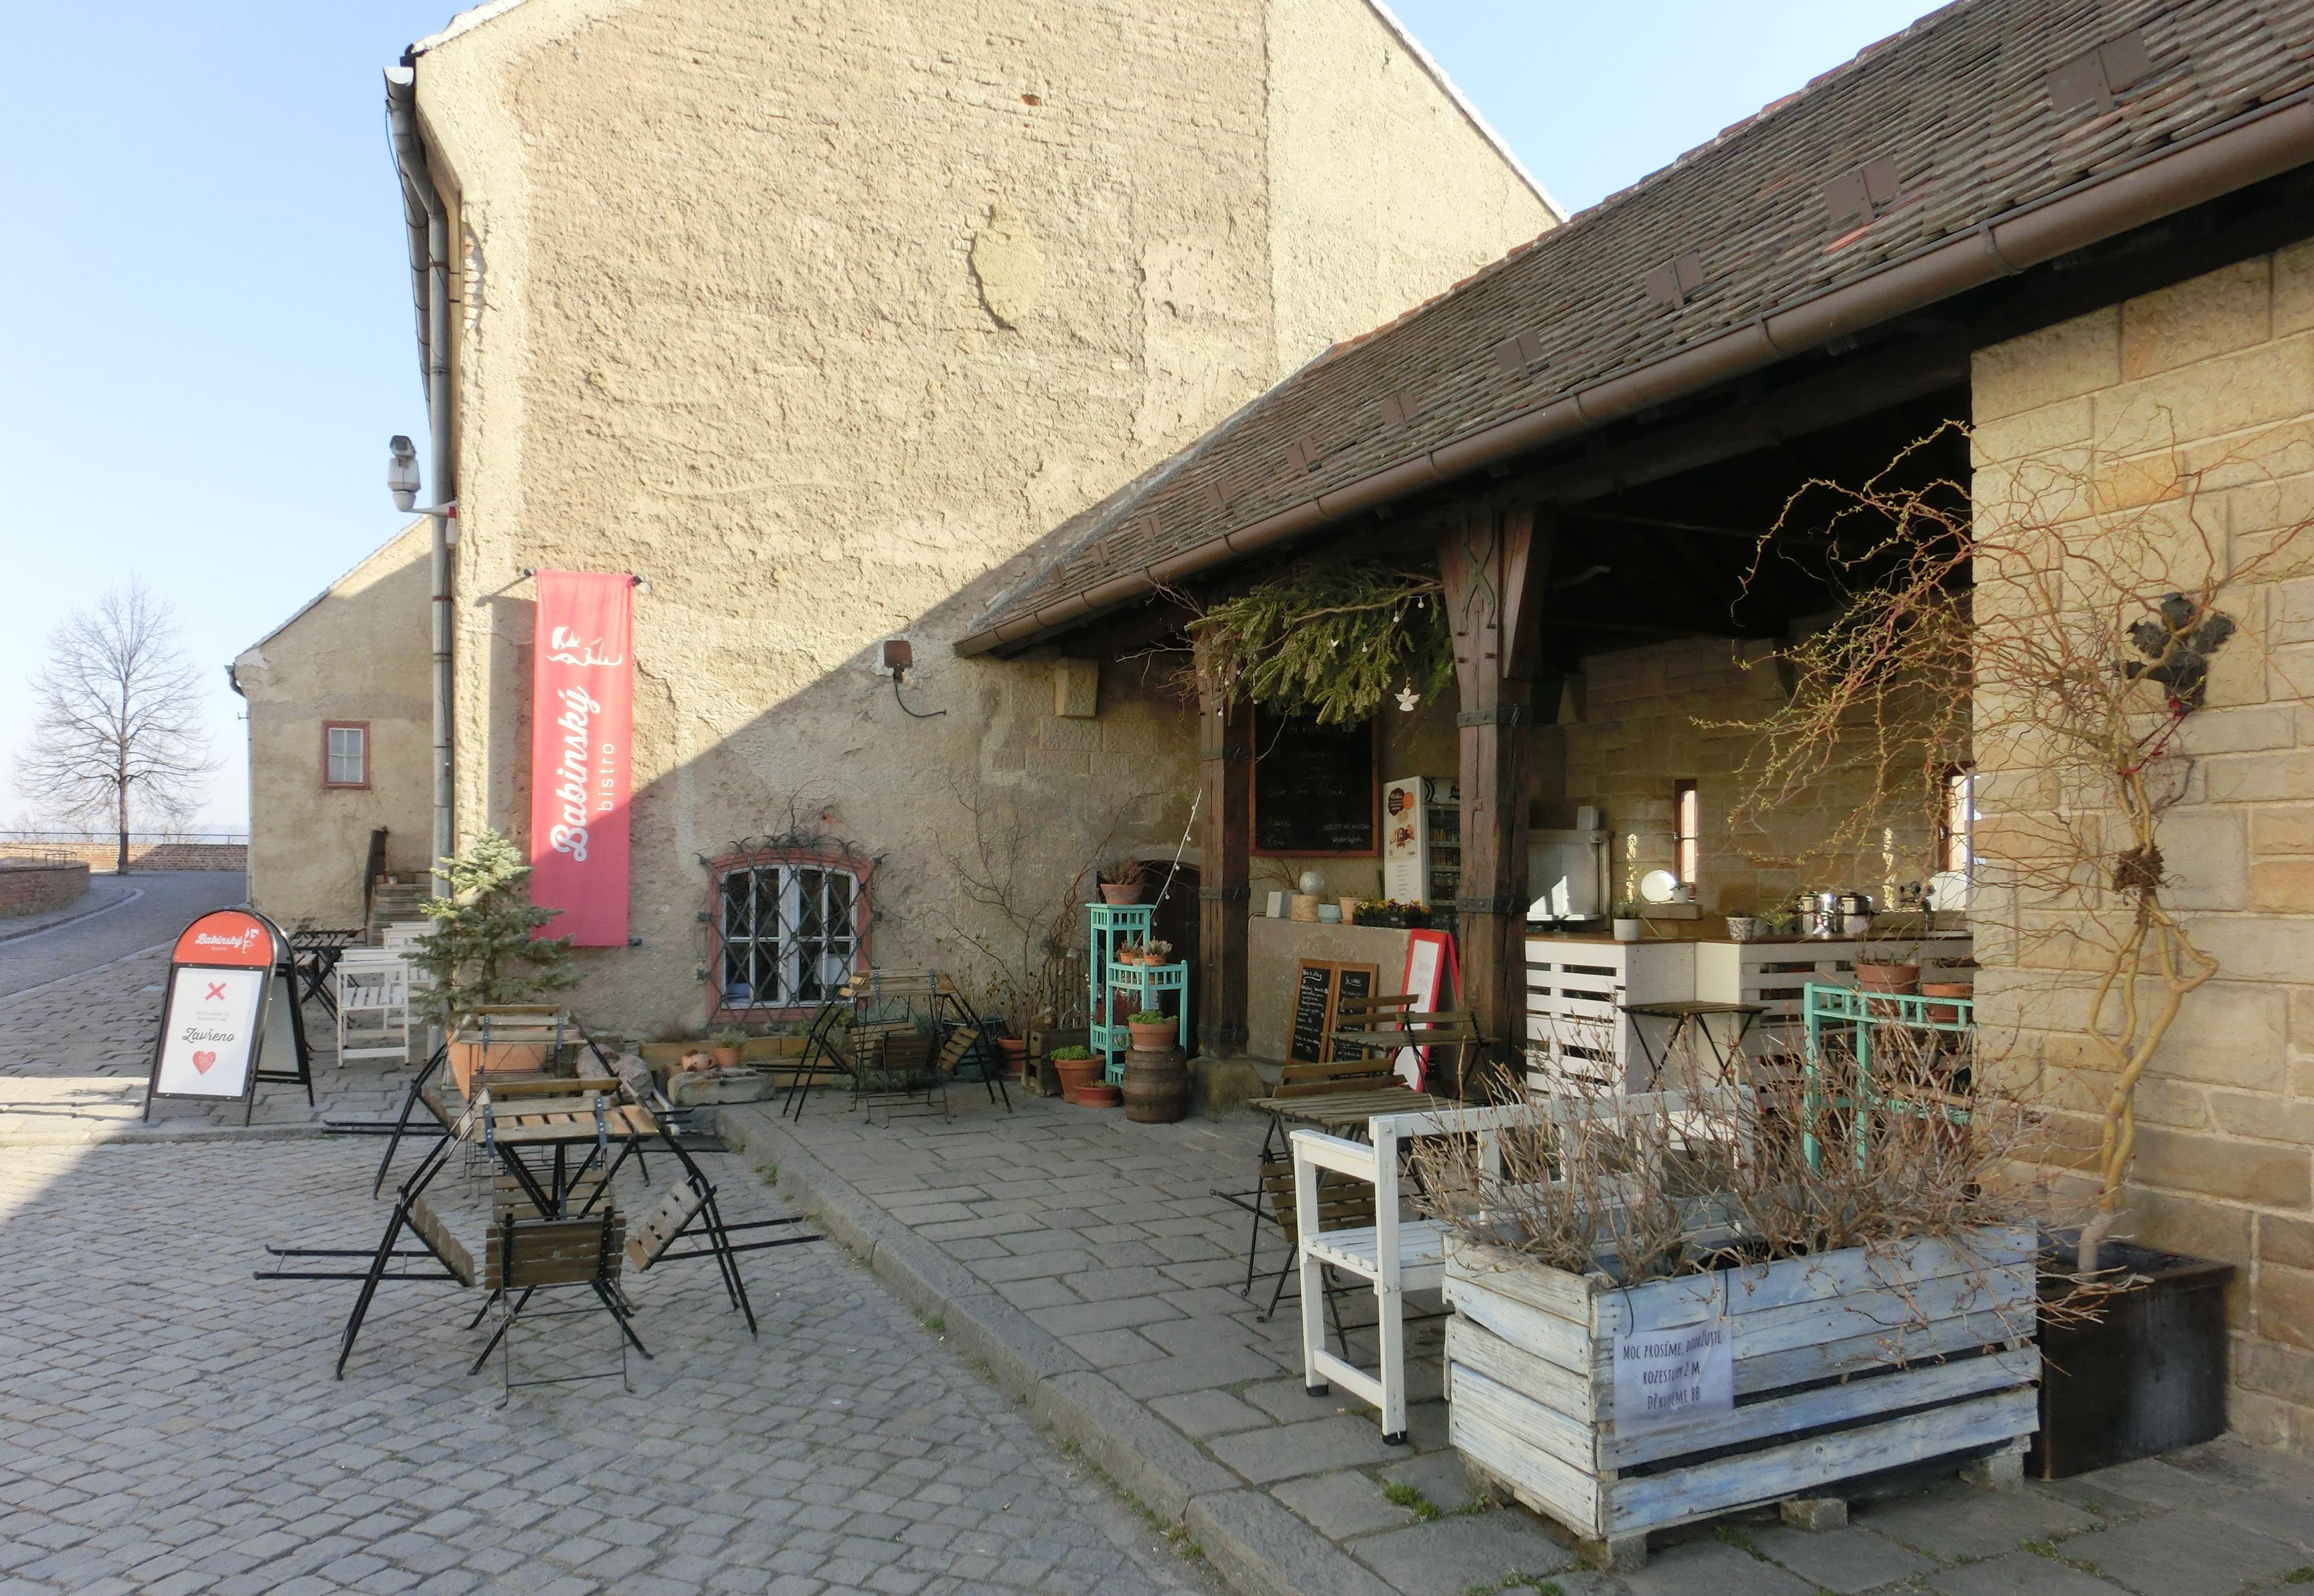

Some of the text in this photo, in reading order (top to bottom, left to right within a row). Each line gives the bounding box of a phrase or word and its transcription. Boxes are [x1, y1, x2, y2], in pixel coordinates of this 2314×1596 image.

[550, 686, 600, 862] Babinský
[598, 743, 614, 811] bistro
[195, 933, 243, 948] Babinský
[182, 1027, 236, 1043] Zavřeno
[1623, 1345, 1641, 1360] MOC
